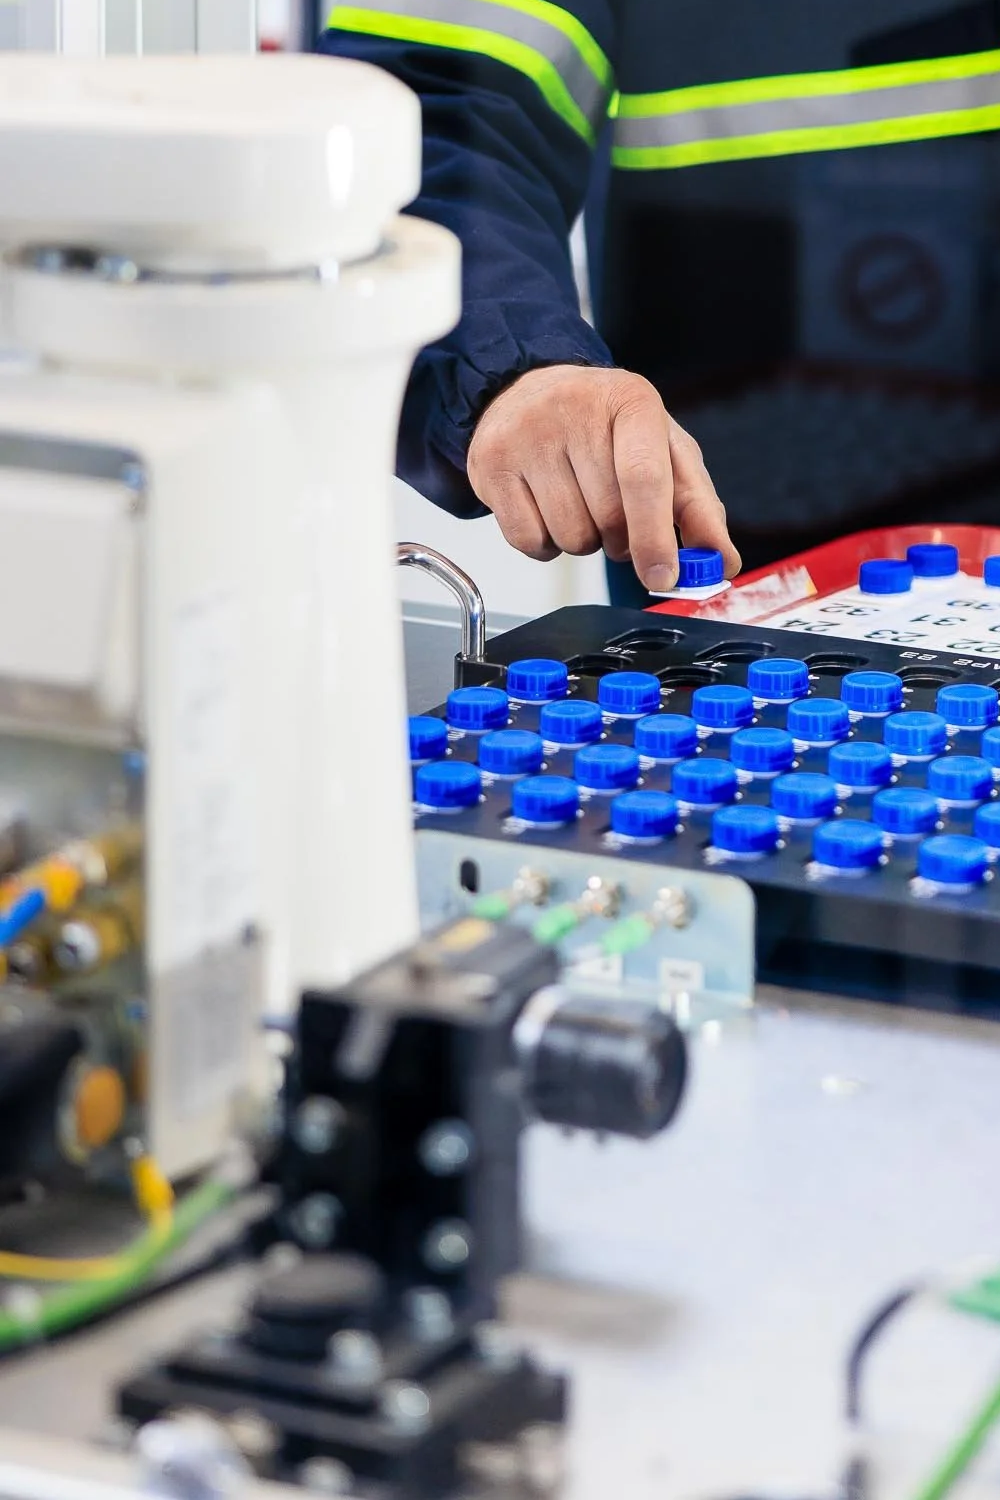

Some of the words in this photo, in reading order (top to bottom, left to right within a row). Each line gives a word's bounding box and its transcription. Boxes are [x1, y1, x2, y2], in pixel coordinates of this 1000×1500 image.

[819, 602, 880, 617] 32
[780, 617, 841, 632] 24
[908, 614, 967, 627] 31
[863, 629, 928, 643] 23
